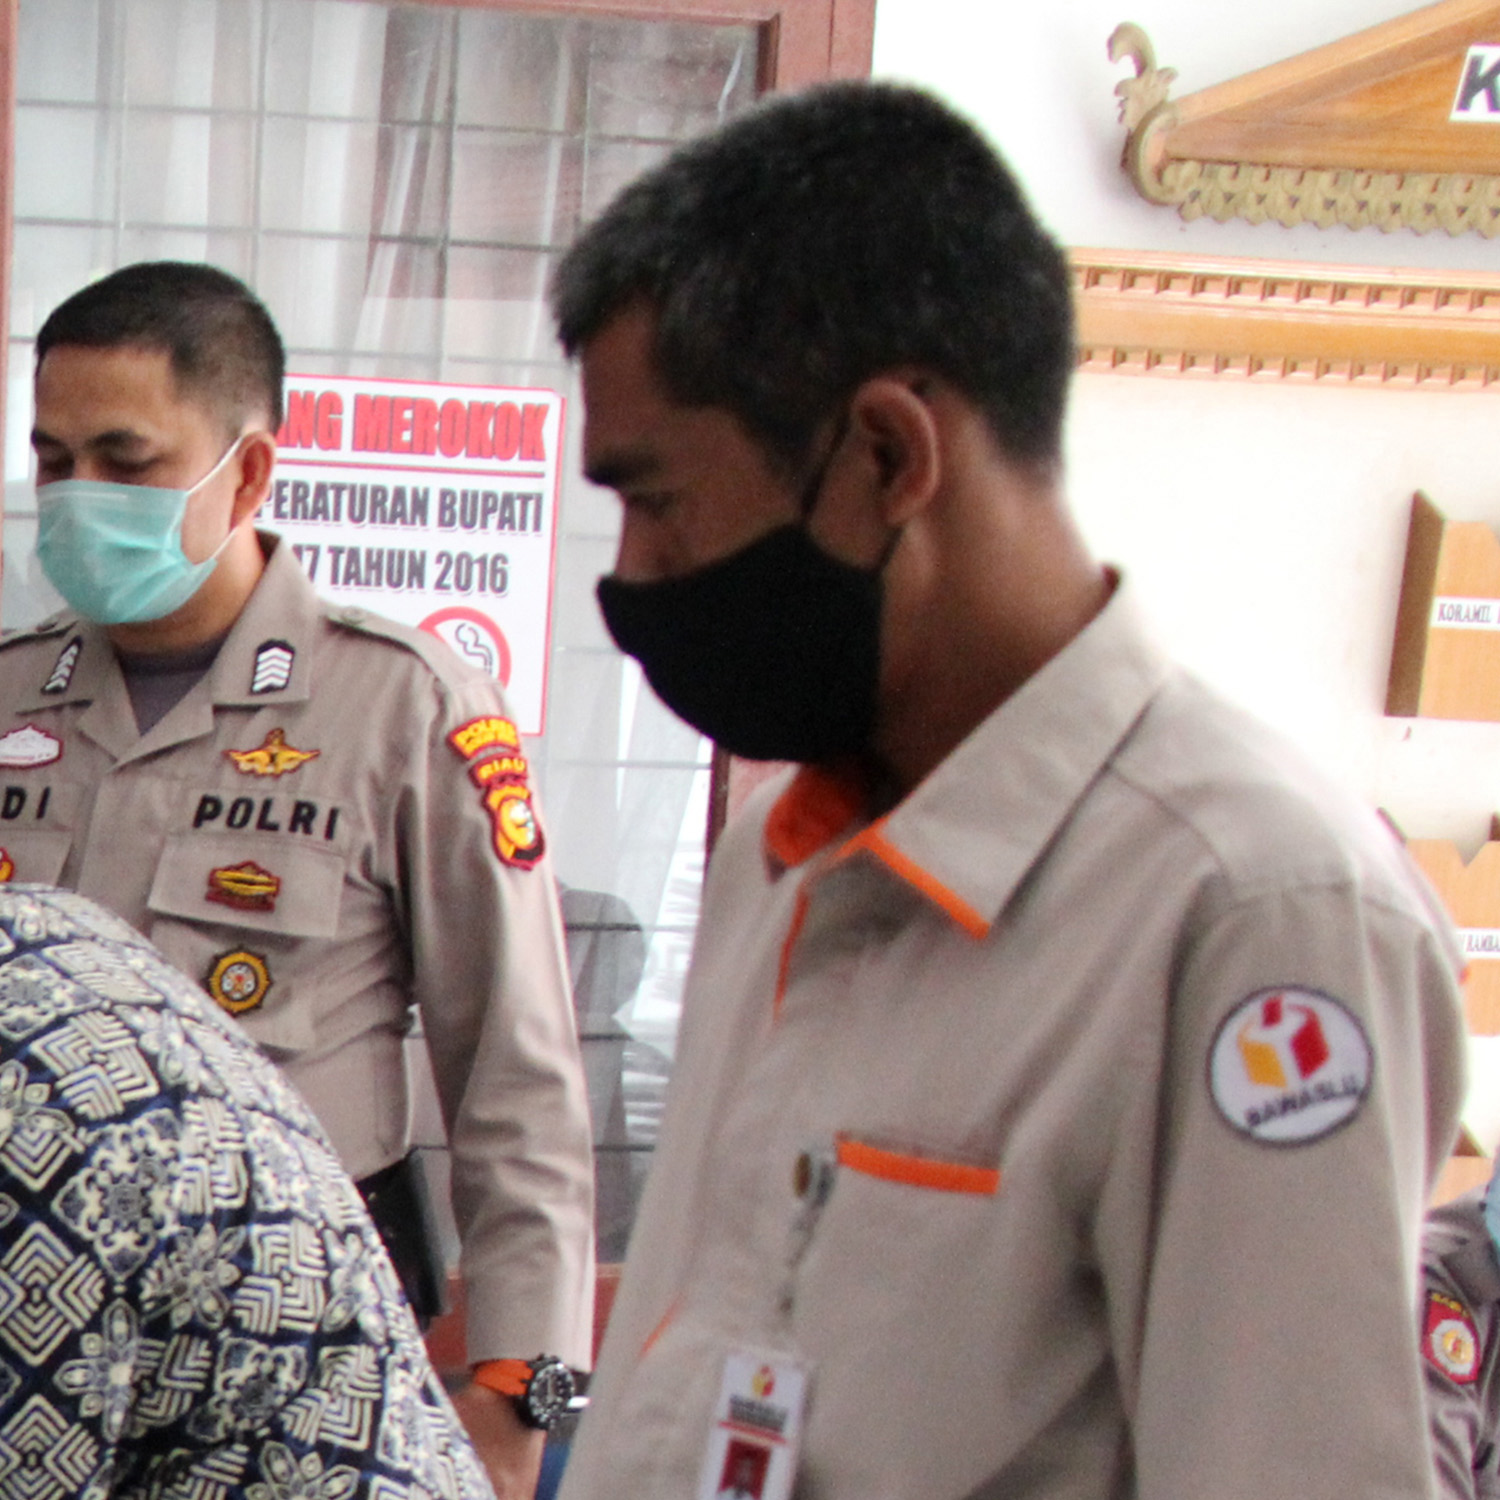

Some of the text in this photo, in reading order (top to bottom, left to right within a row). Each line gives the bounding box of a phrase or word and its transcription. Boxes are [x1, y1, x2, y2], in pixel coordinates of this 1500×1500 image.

[276, 390, 550, 462] NG MEROKOK
[437, 487, 544, 533] BUPATI
[327, 545, 427, 590] TAHUN
[434, 550, 510, 594] 2016
[1438, 603, 1491, 623] KORAMIL
[478, 757, 526, 780] RIAU
[192, 794, 341, 841] POLRI
[1245, 1073, 1361, 1128] BAWASLU
